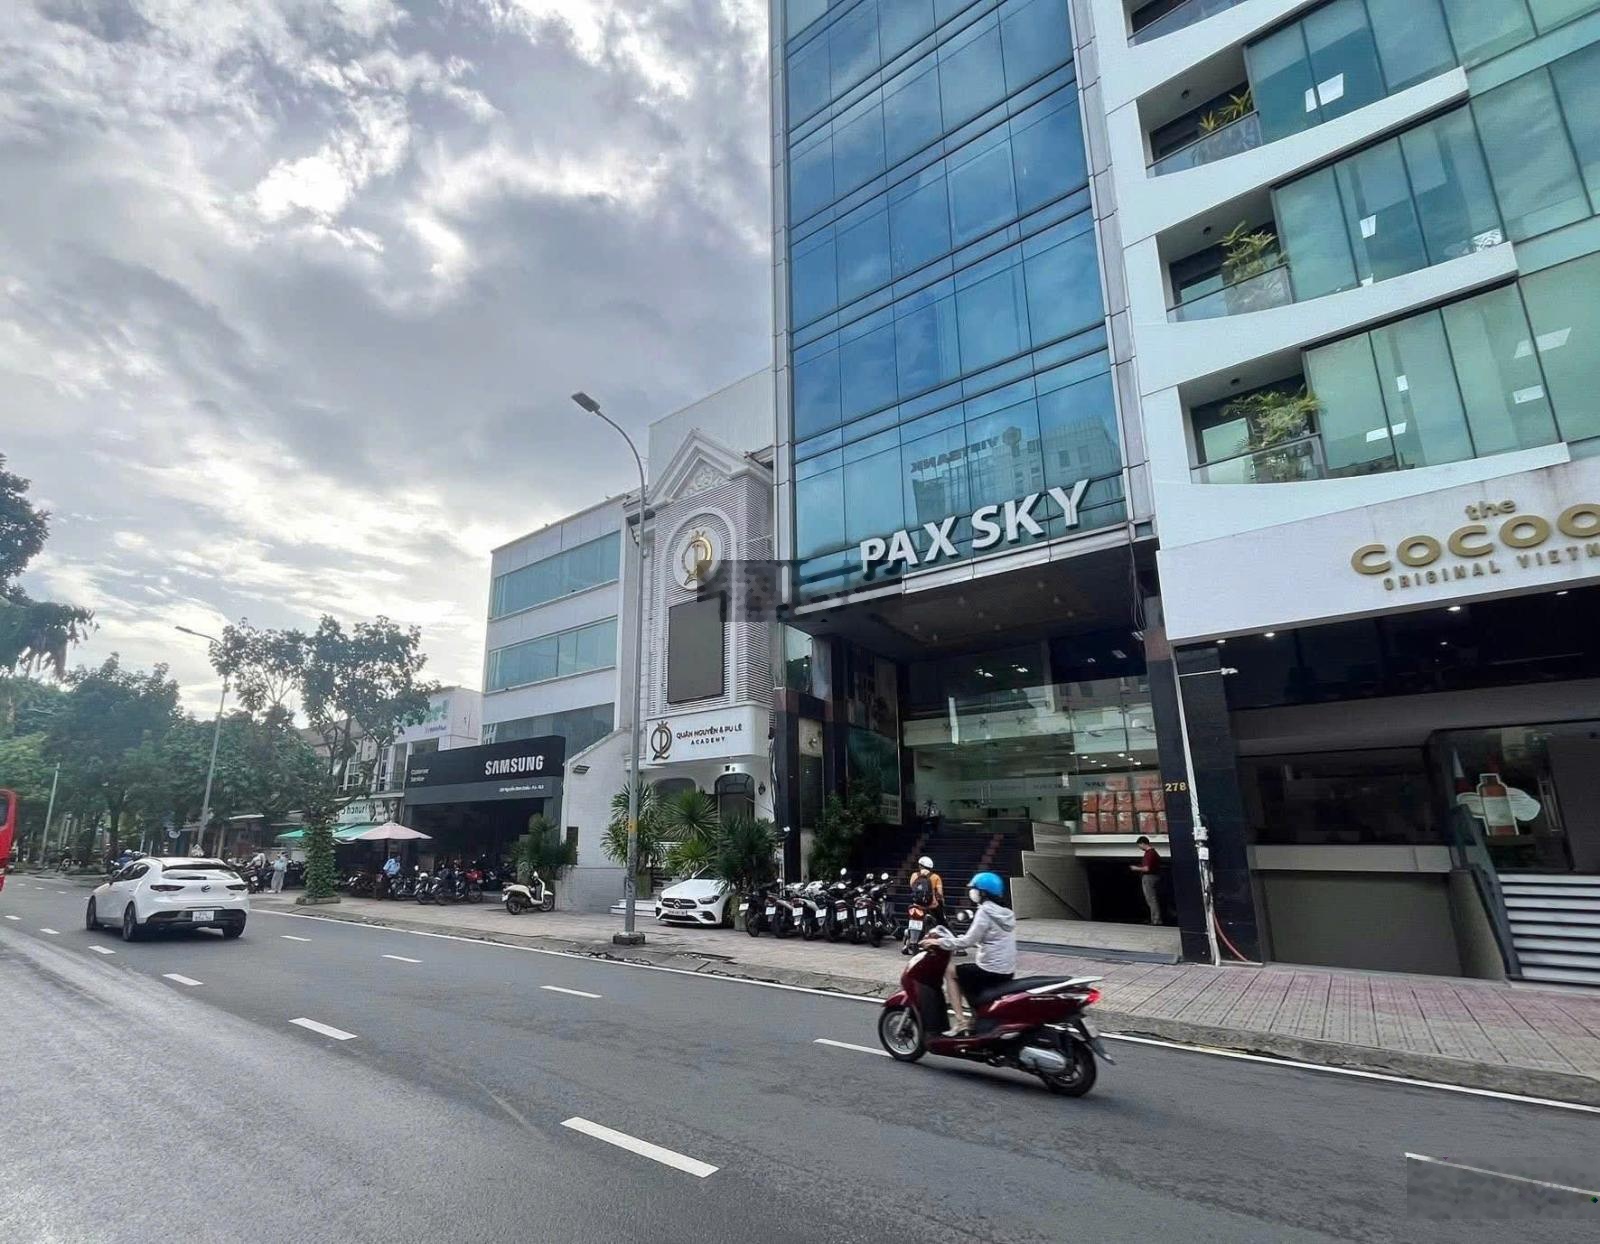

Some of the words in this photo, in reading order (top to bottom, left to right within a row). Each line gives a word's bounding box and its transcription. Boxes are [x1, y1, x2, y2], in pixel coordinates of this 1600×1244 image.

[1465, 499, 1516, 520] the
[859, 515, 959, 574] PAX
[971, 478, 1091, 549] SKY
[1383, 560, 1501, 591] ORIGINAL
[691, 736, 725, 745] ACADEMY
[485, 755, 544, 776] SAMSUNG
[1165, 781, 1187, 792] 278
